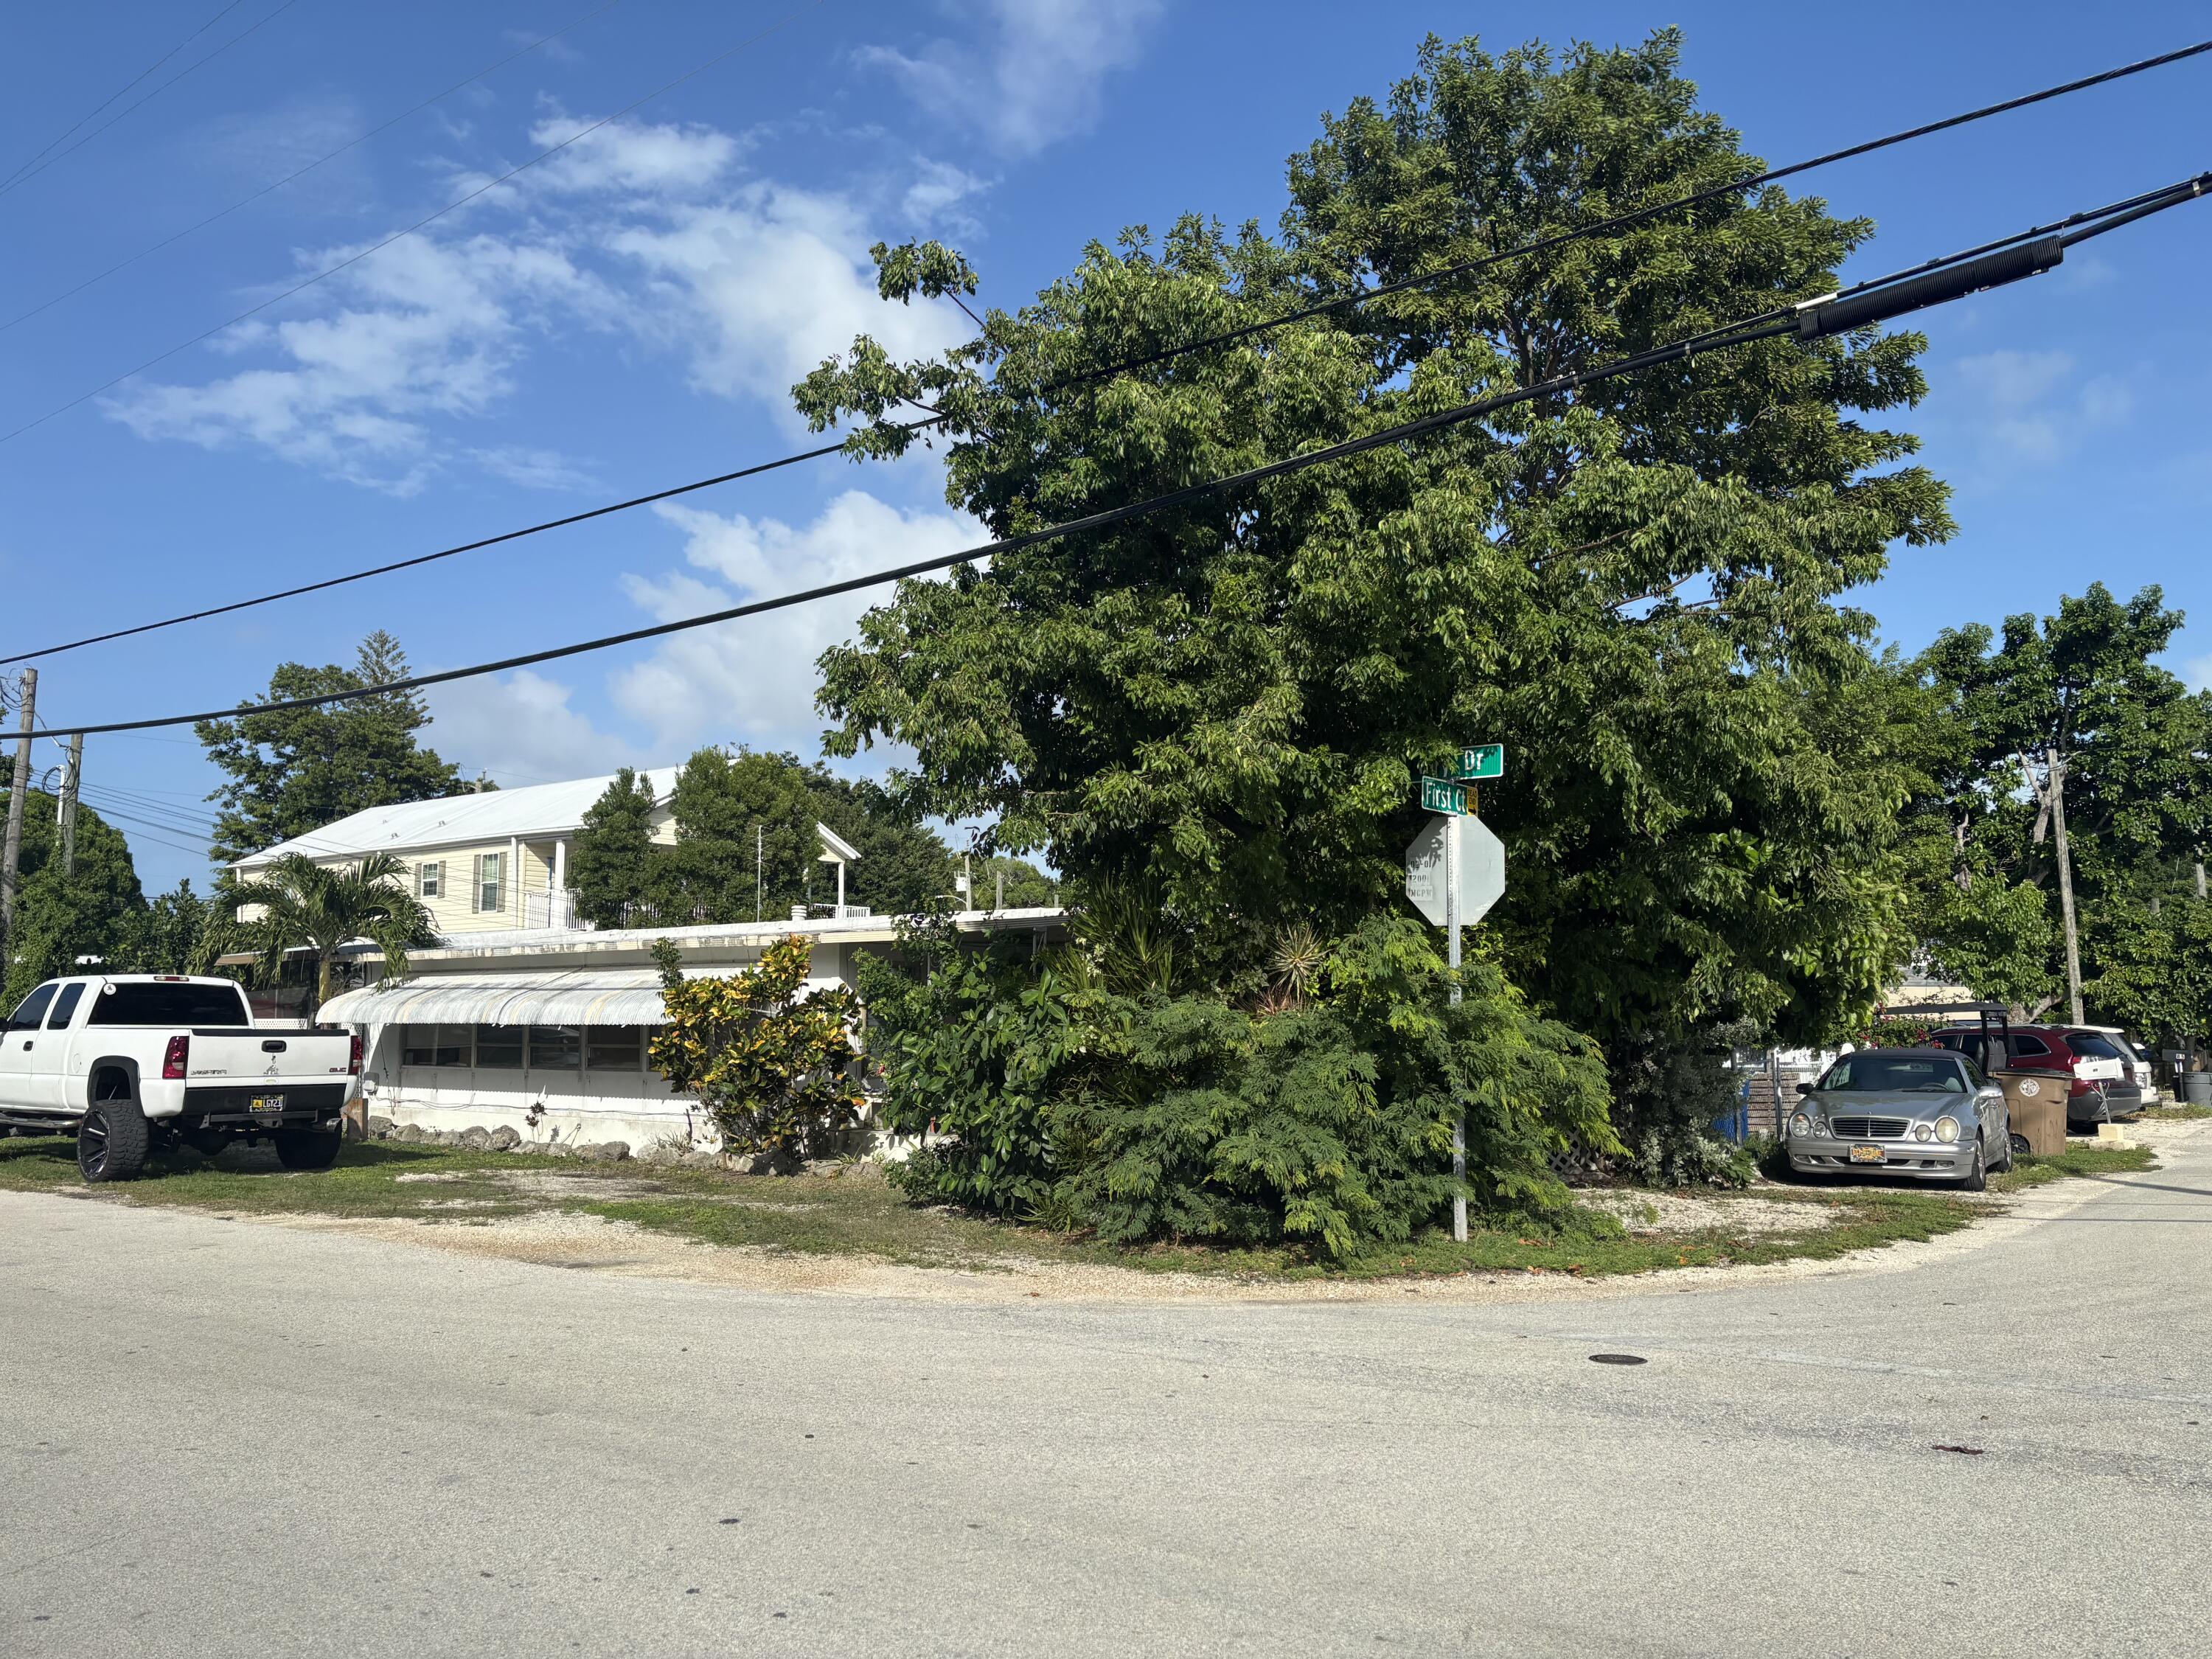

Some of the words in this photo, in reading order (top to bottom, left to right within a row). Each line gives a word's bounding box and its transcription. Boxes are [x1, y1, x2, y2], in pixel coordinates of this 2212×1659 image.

[1464, 749, 1484, 771] Dr
[1426, 782, 1452, 810] First
[1455, 788, 1466, 813] Ct
